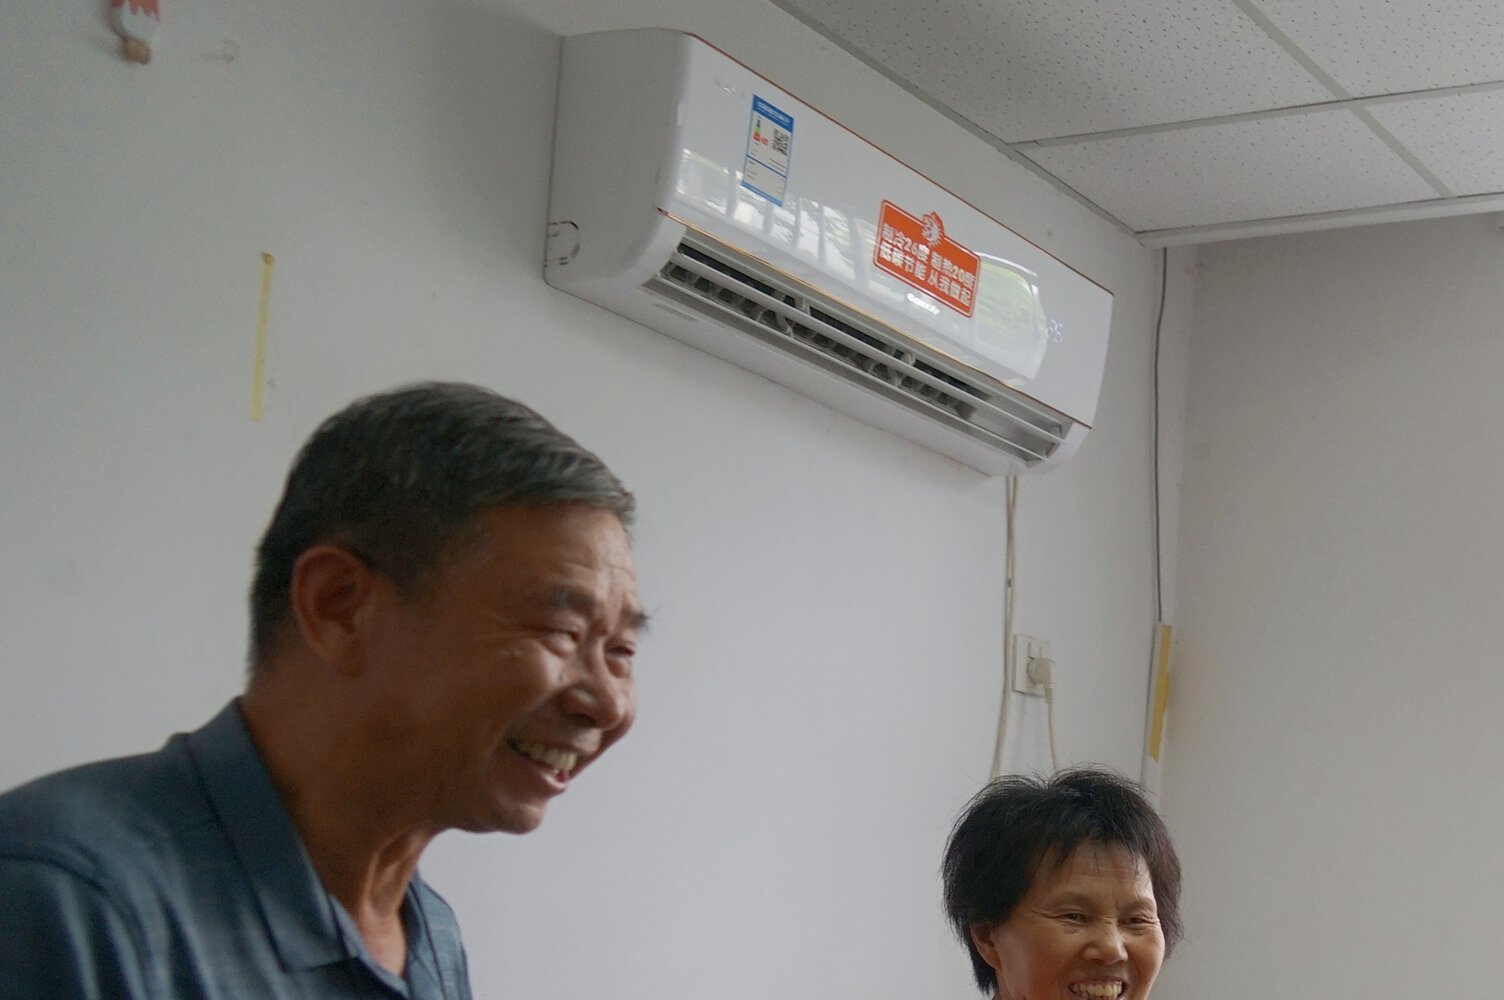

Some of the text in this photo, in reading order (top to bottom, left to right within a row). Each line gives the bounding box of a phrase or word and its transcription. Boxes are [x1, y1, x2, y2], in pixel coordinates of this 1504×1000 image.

[880, 241, 927, 280] 低碳节能
[927, 270, 971, 305] 从我做起
